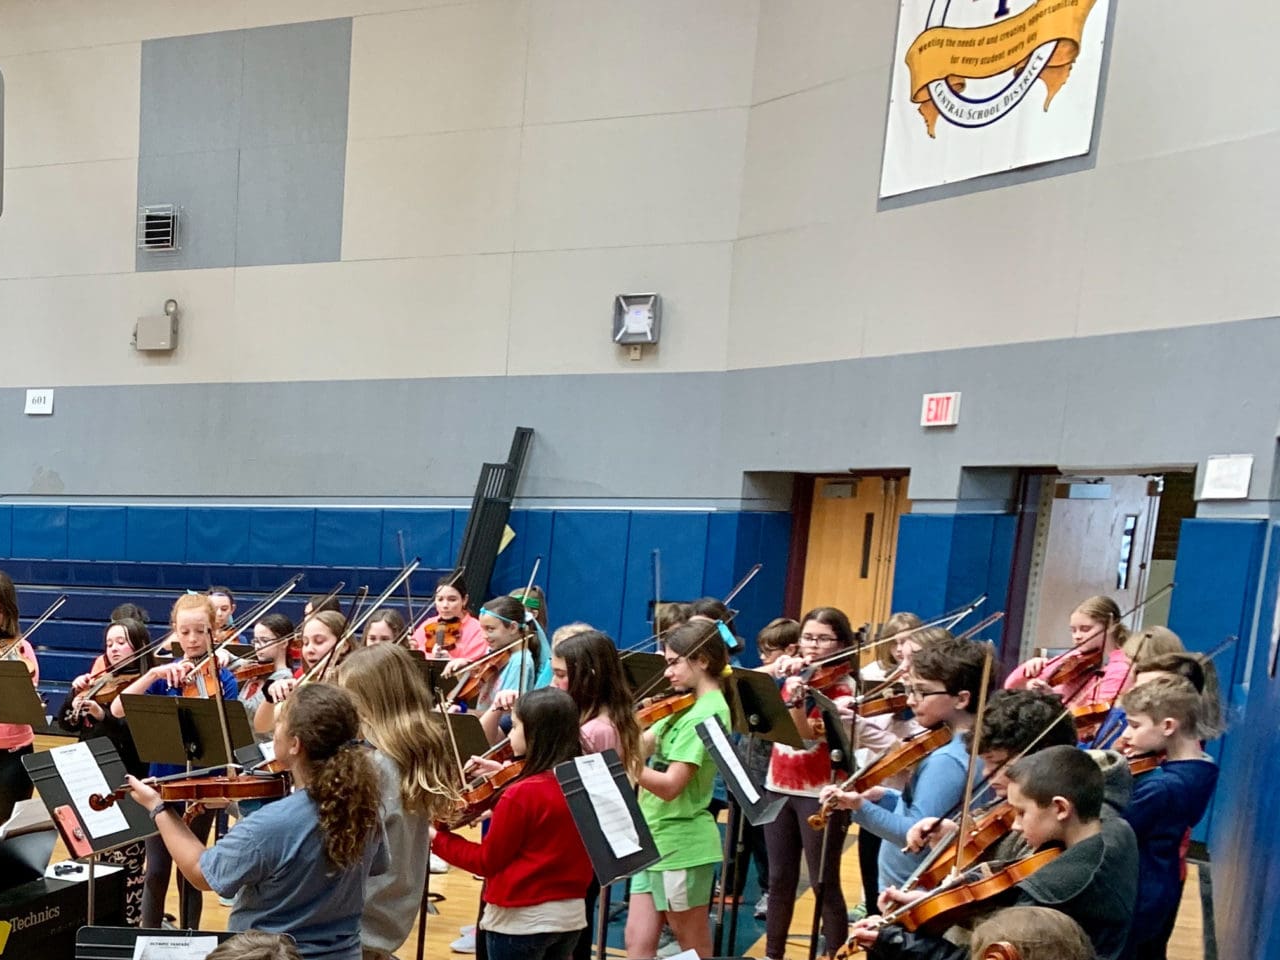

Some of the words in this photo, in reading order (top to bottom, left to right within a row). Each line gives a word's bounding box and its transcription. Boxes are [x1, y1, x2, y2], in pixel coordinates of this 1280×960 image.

[945, 38, 955, 47] the
[957, 38, 976, 47] needs
[978, 36, 985, 46] of
[986, 35, 998, 45] and
[1000, 23, 1026, 41] creating
[1028, 0, 1078, 26] opportunities
[961, 56, 979, 67] every
[980, 51, 1005, 65] student
[1007, 41, 1024, 56] every
[32, 395, 46, 405] 601
[927, 397, 952, 422] EXIT
[10, 905, 60, 933] Technics
